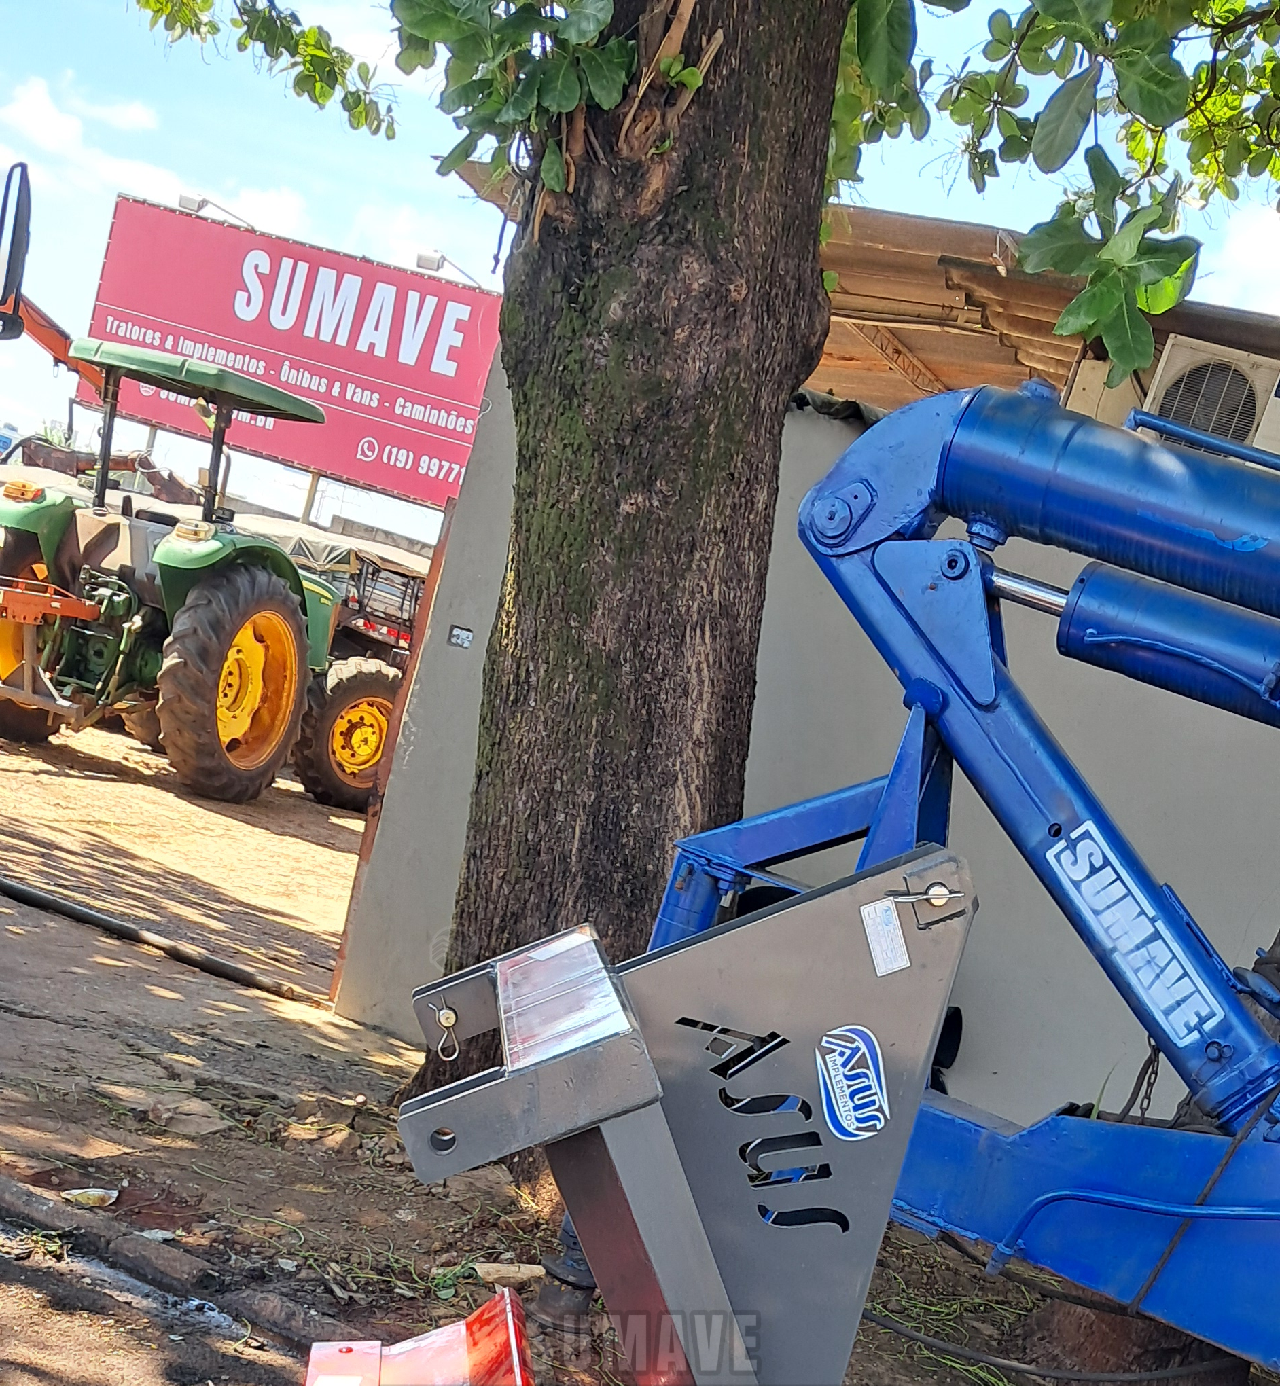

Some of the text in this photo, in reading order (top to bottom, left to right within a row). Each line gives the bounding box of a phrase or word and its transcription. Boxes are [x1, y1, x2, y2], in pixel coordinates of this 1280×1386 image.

[234, 249, 472, 377] SUMAVE
[105, 315, 162, 347] Tratores
[164, 334, 174, 350] &
[177, 335, 266, 375] Implementos
[279, 360, 328, 393] Ônibus
[331, 381, 341, 397] &
[345, 382, 380, 408] Vans
[394, 396, 475, 434] Caminhões
[382, 444, 414, 470] (19)
[1060, 838, 1212, 1040] SUMAVE
[674, 1016, 850, 1234] ASUS
[821, 1035, 885, 1130] ASUS
[828, 1054, 856, 1128] IMPLEMENTOS
